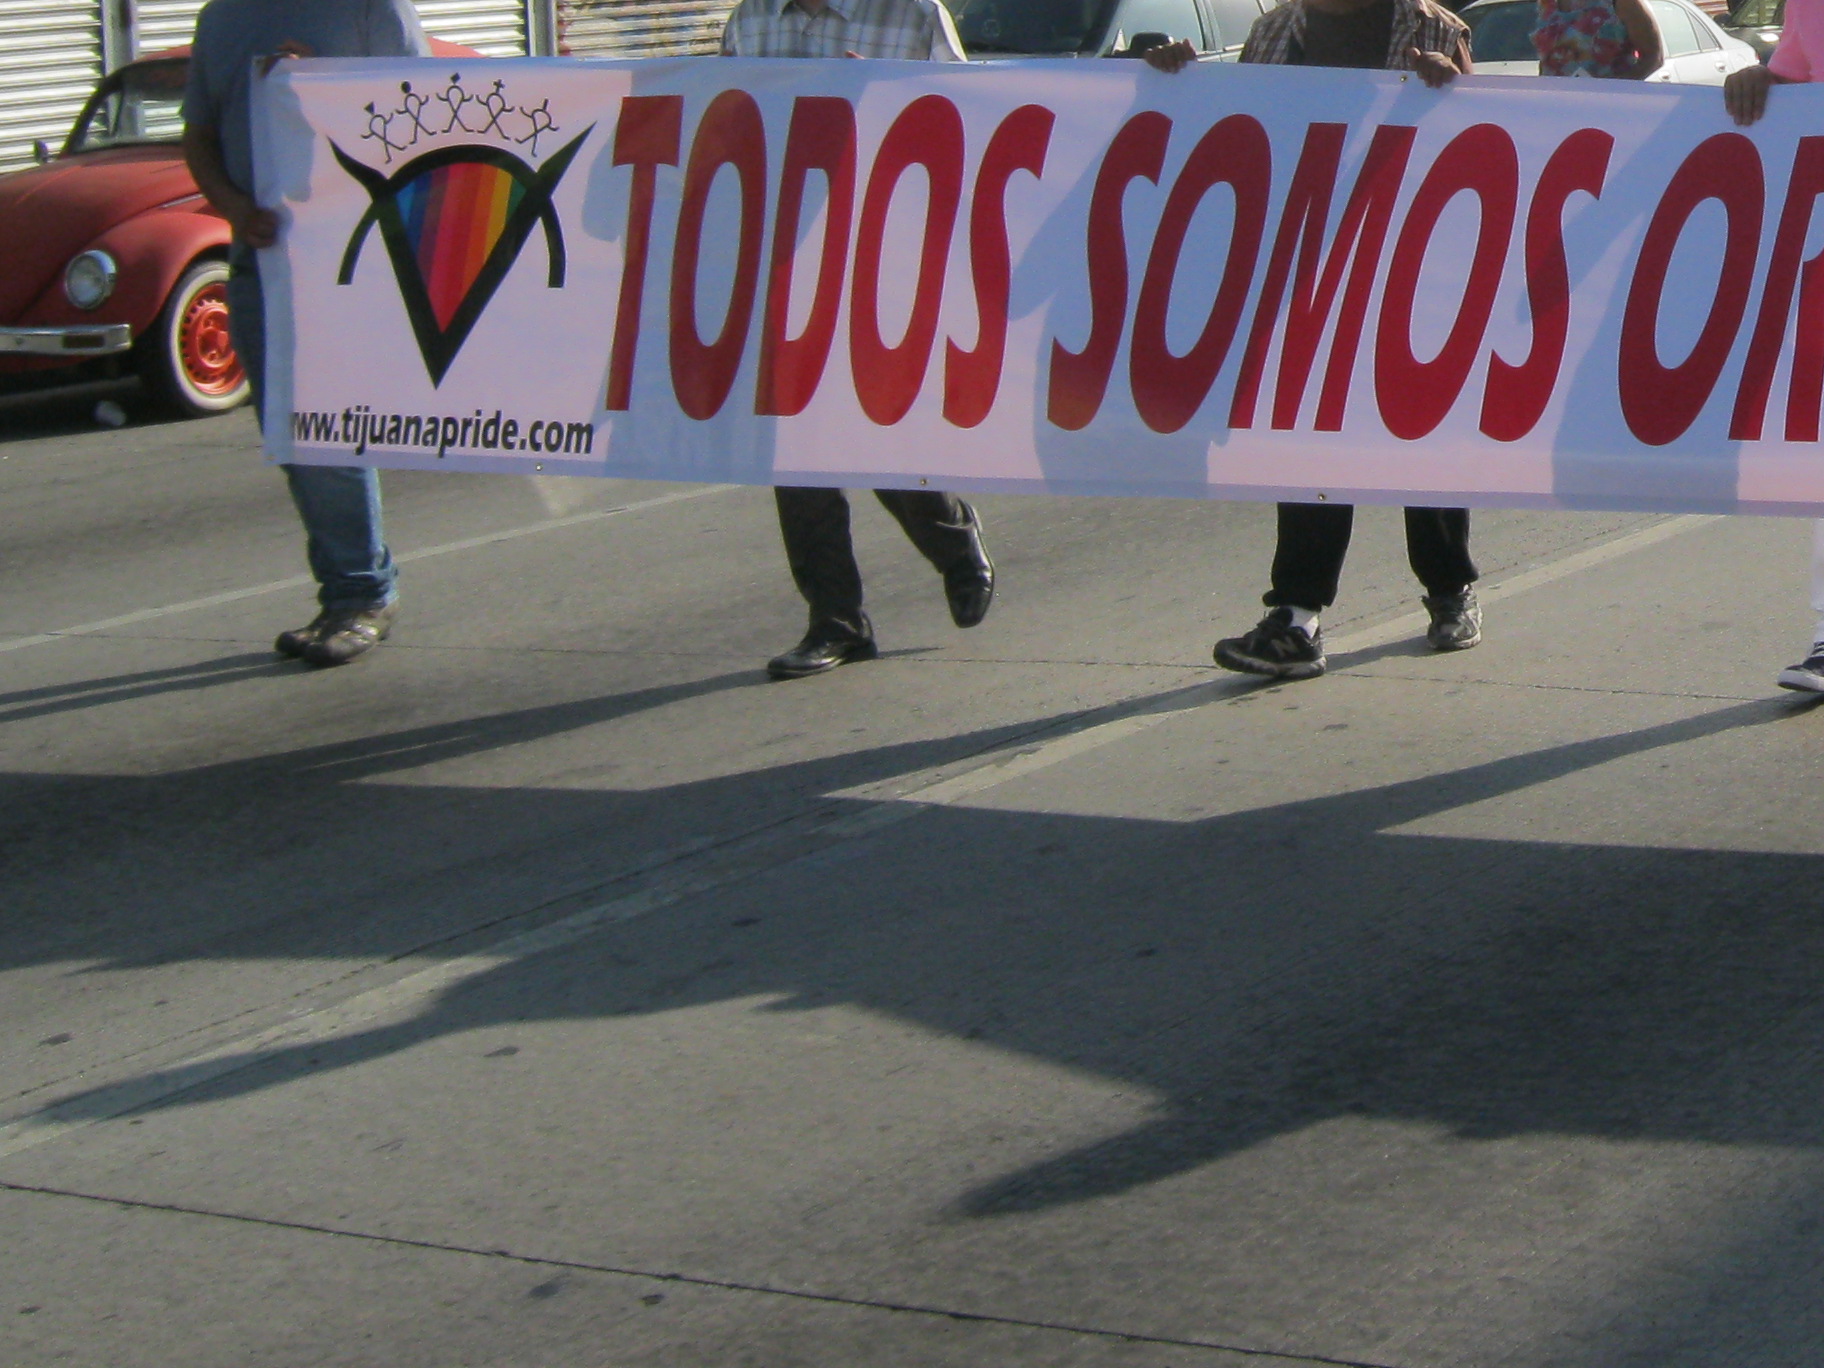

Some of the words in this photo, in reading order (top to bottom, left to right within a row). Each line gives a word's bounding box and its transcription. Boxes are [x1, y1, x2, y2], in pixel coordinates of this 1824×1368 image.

[606, 89, 1056, 429] TODOS
[1047, 110, 1616, 443] SOMOS
[289, 405, 594, 459] ww.tijuanapride.com
